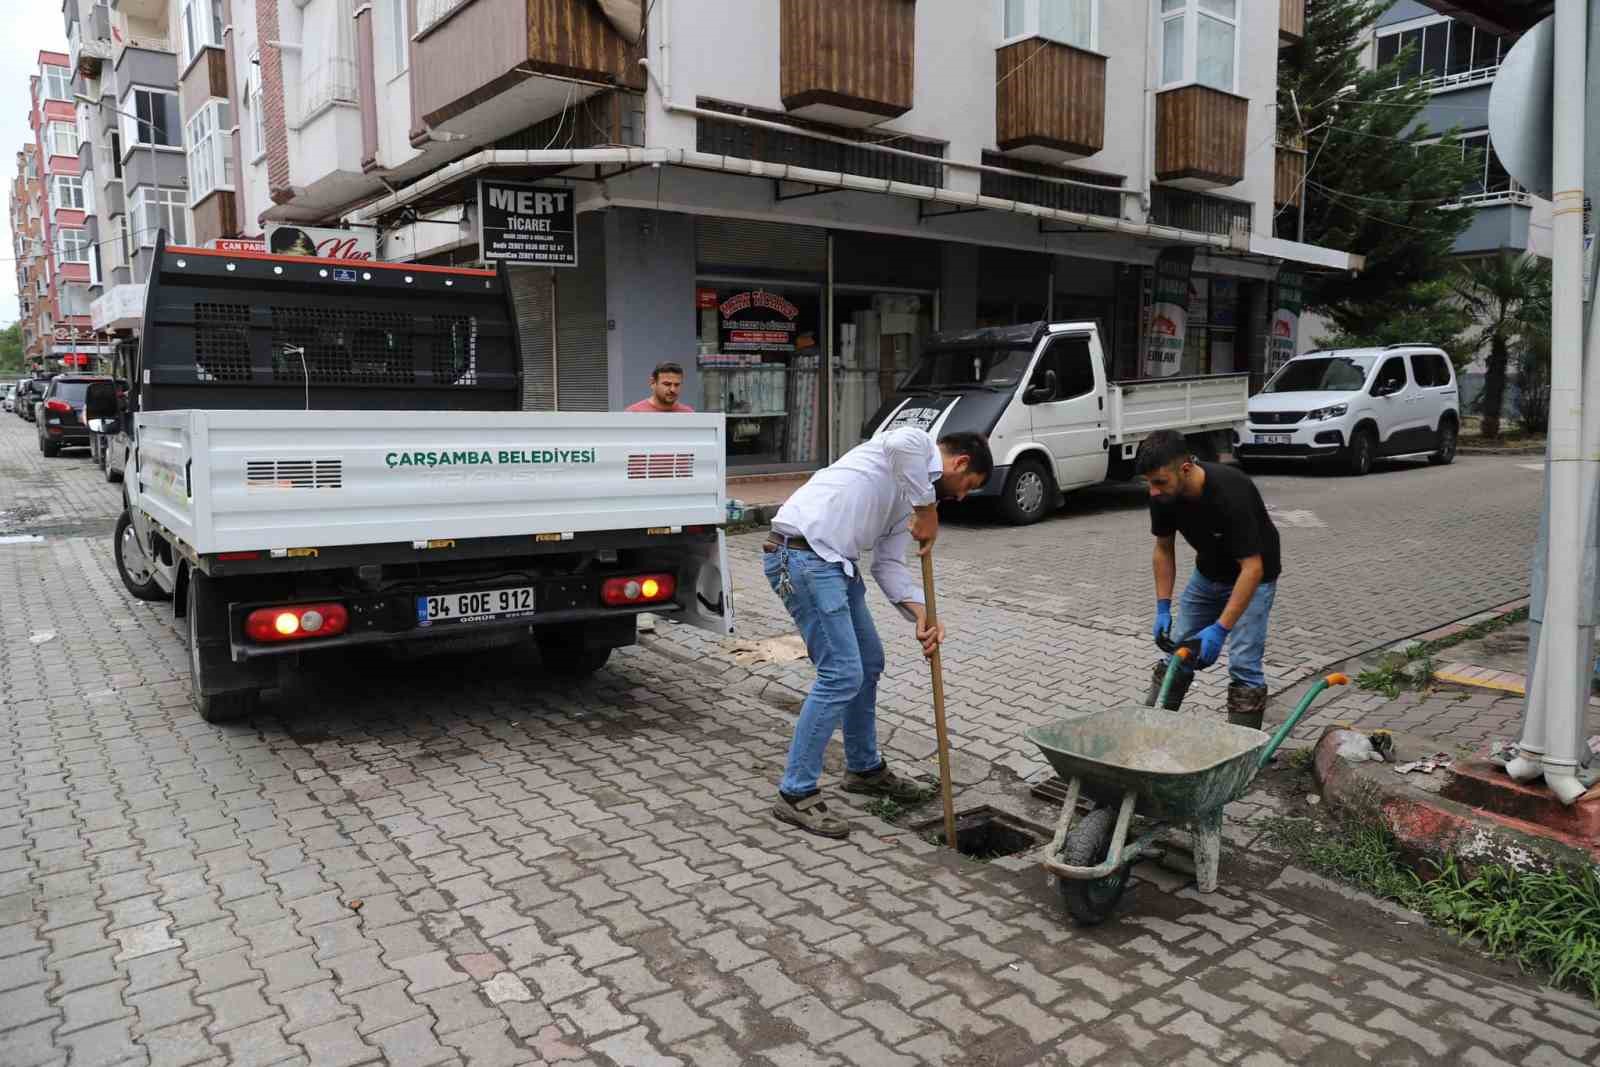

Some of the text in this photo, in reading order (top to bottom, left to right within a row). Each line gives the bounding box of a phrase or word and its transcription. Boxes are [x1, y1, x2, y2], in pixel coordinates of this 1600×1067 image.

[489, 187, 568, 215] MERT
[507, 215, 552, 232] TİCARET
[222, 242, 242, 250] CAN
[385, 447, 596, 469] ÇARŞAMBA BELEDİYESİ
[428, 597, 450, 618] 34
[458, 592, 491, 615] GOE
[499, 589, 531, 611] 912
